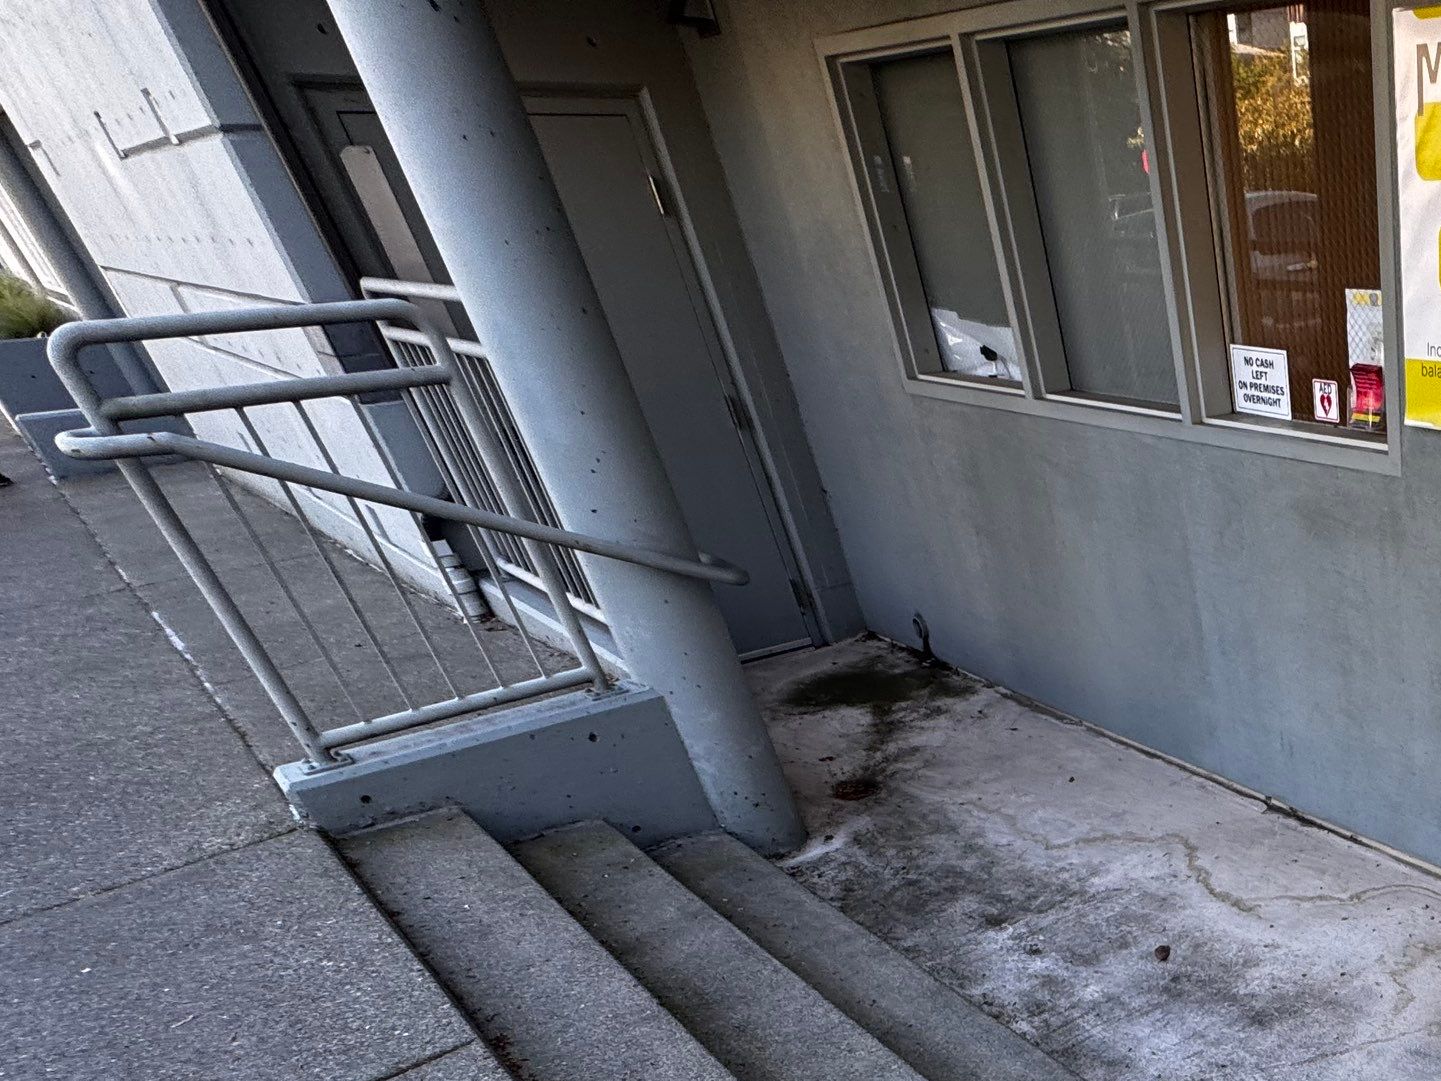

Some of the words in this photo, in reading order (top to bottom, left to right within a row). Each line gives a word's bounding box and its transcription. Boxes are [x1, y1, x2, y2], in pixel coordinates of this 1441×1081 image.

[1243, 356, 1254, 367] NO
[1255, 357, 1275, 370] CASH
[1251, 370, 1268, 381] LEFT
[1238, 380, 1248, 390] ON
[1249, 382, 1285, 396] PREMISES
[1319, 383, 1333, 395] AED
[1243, 393, 1282, 408] OVERNIGHT
